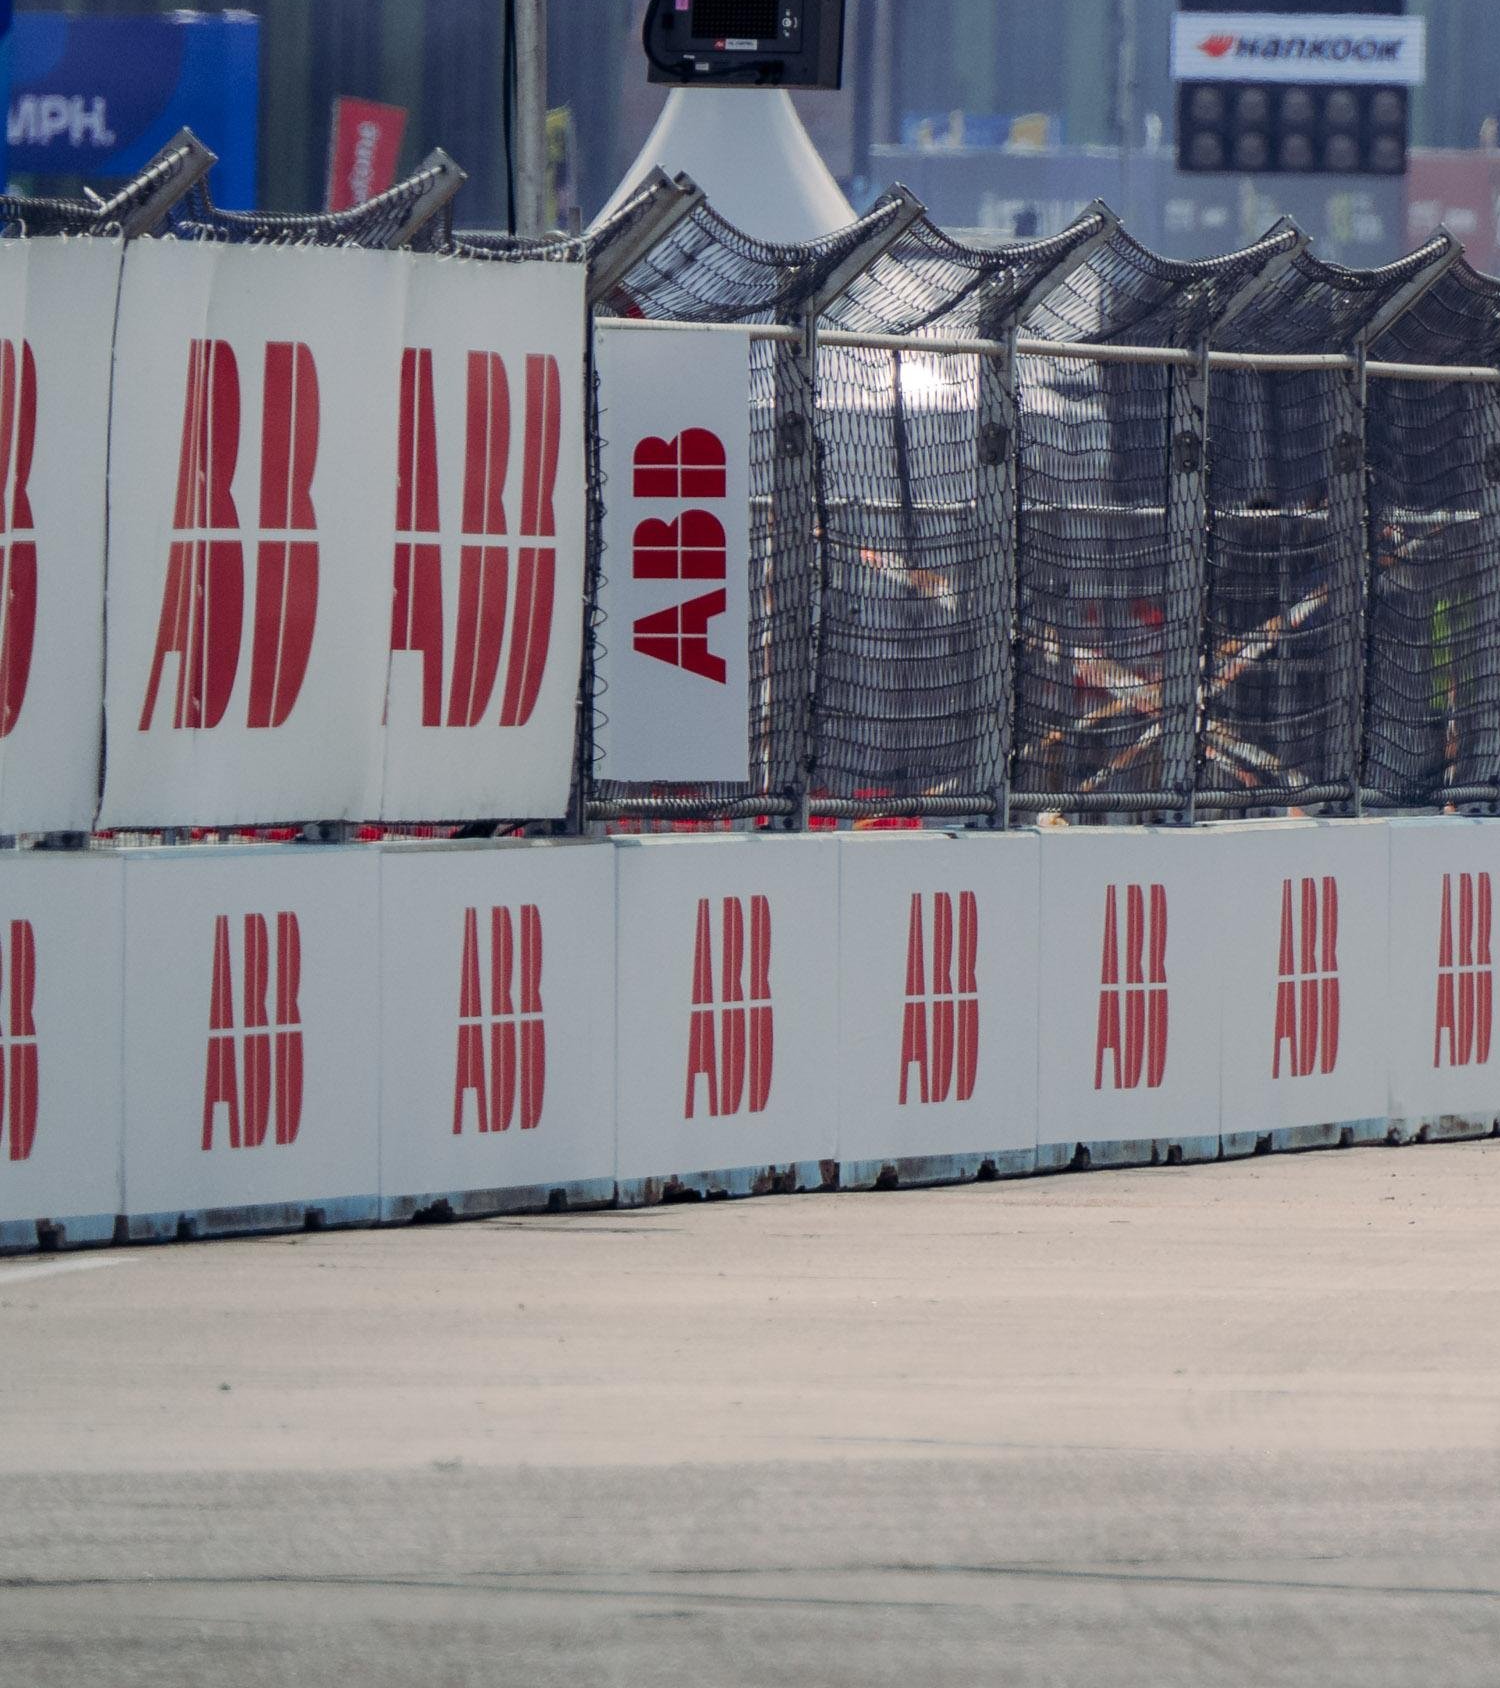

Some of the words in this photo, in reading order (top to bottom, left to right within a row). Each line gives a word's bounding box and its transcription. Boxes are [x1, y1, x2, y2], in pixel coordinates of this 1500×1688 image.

[1233, 35, 1401, 67] Hankook
[139, 338, 321, 732] ABB
[382, 347, 562, 728] ABB
[632, 426, 728, 686] ABB
[202, 911, 305, 1151] ABB
[453, 904, 546, 1135] ABB
[684, 894, 774, 1120] ABB
[898, 890, 979, 1105] ABB
[1094, 883, 1169, 1090] ABB
[1272, 875, 1341, 1080] ABB
[1433, 871, 1494, 1068] ABB
